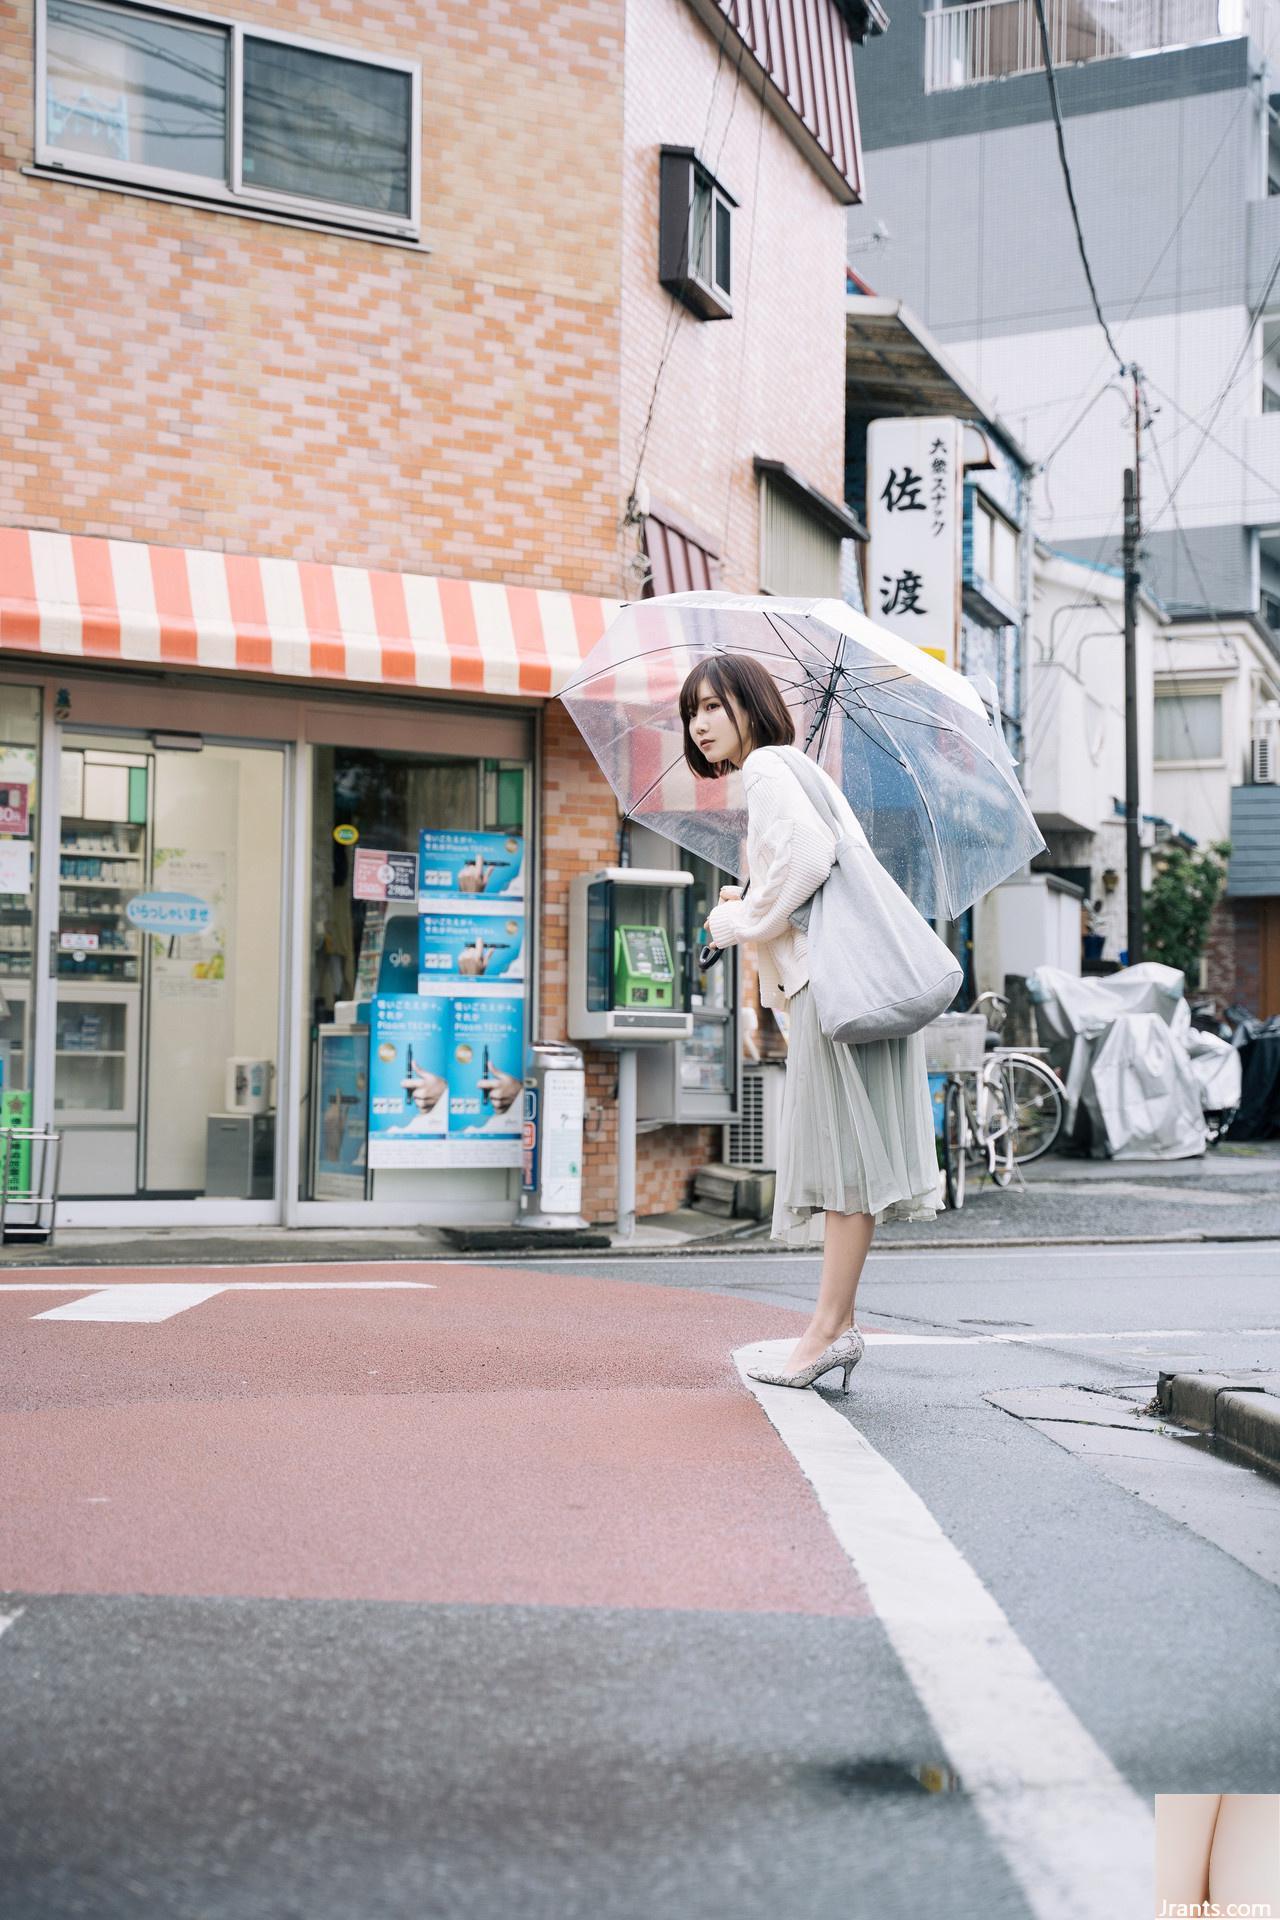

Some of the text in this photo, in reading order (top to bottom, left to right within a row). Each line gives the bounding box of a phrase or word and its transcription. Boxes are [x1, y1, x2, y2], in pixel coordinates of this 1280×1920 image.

[880, 466, 929, 616] 佐渡
[129, 903, 209, 922] いらっしゃいませ
